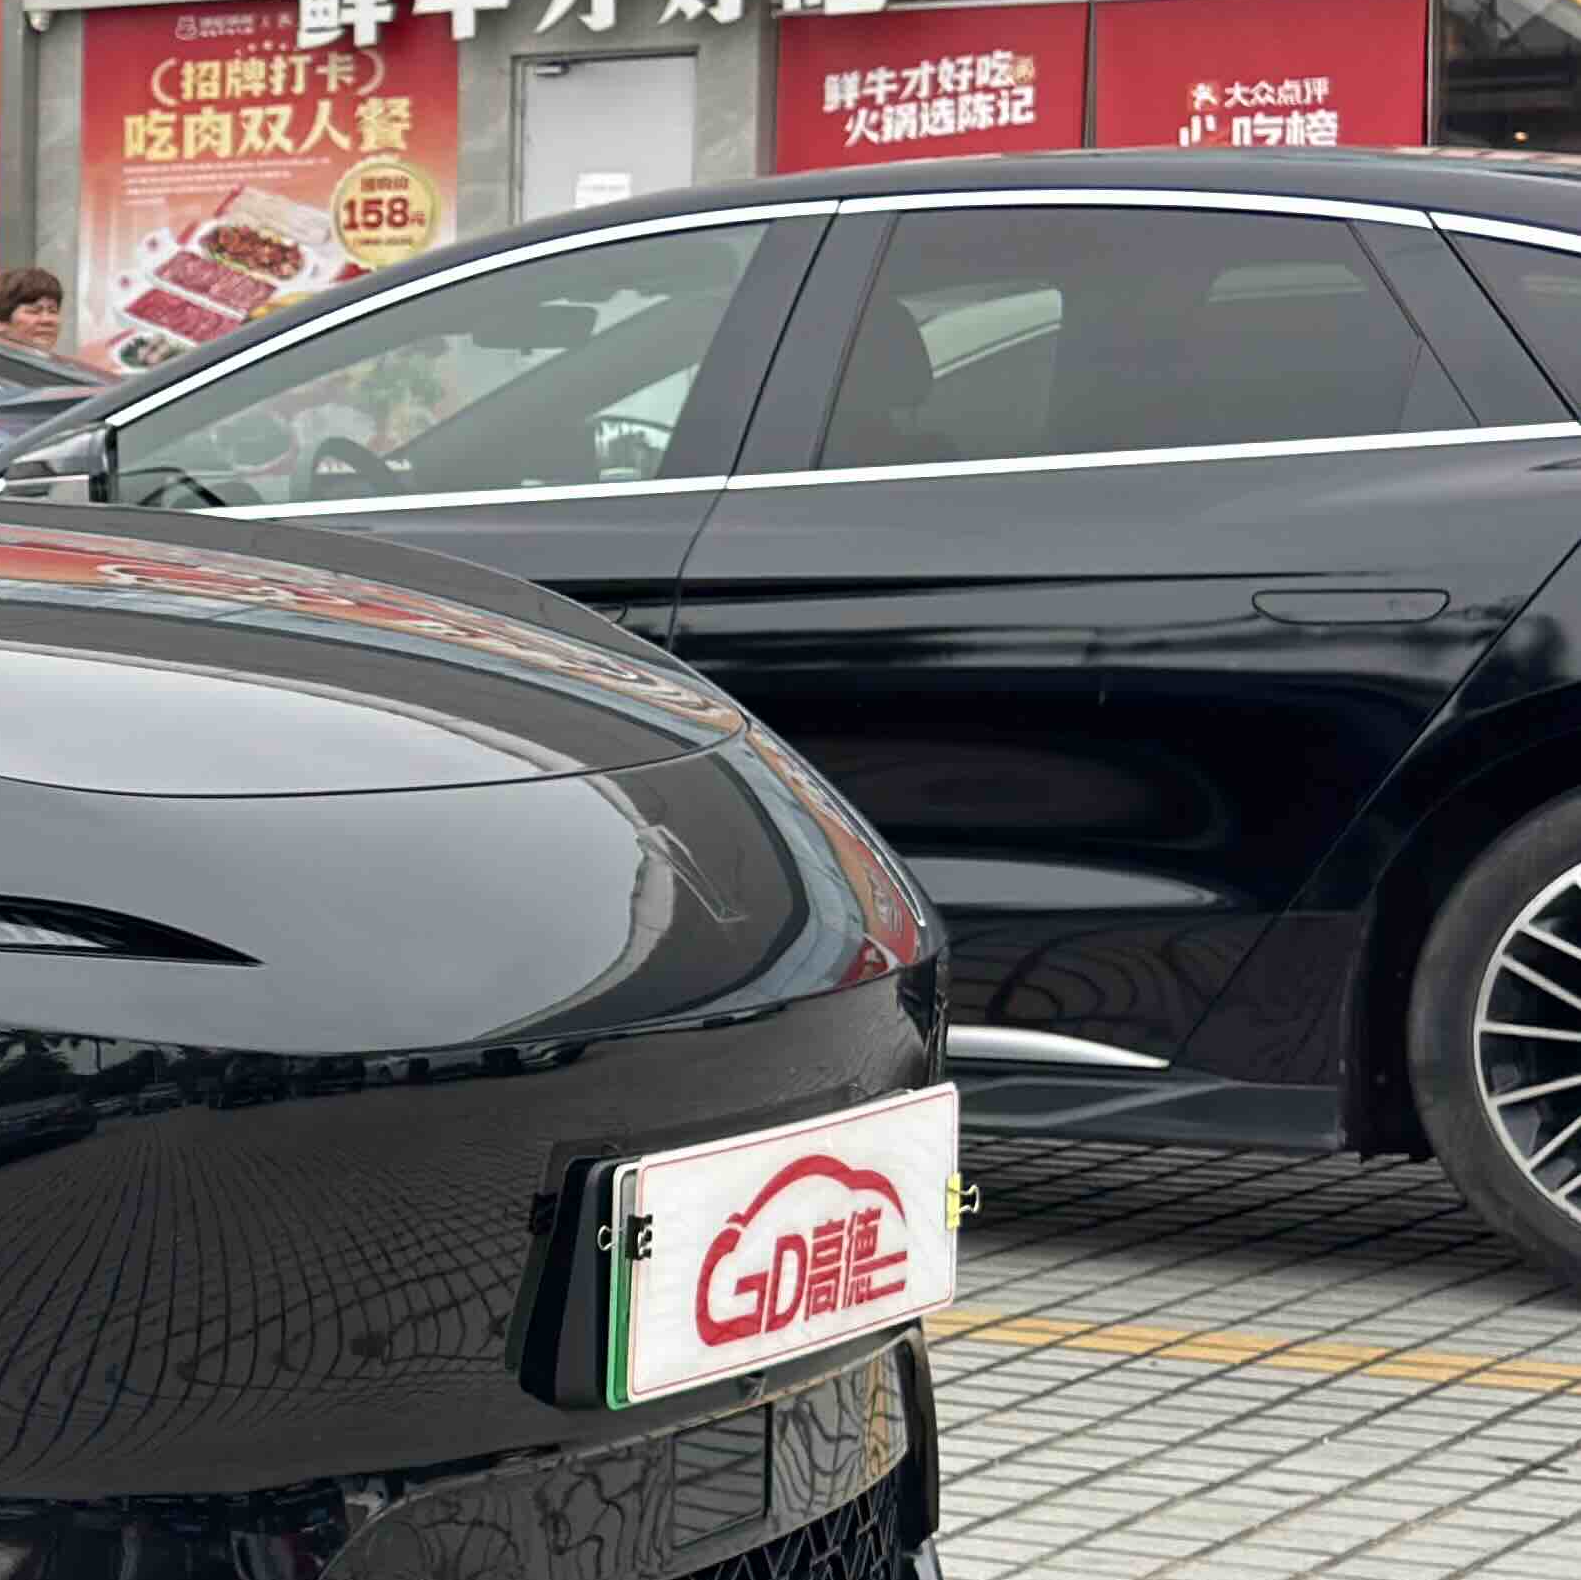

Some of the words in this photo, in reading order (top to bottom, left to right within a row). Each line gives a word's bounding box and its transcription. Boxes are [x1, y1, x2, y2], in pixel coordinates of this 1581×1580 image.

[823, 50, 1015, 112] 鲜牛才好吃
[1224, 77, 1330, 108] 大众点评
[123, 96, 413, 162] 吃肉双人餐
[844, 86, 1036, 148] 火锅选陈记
